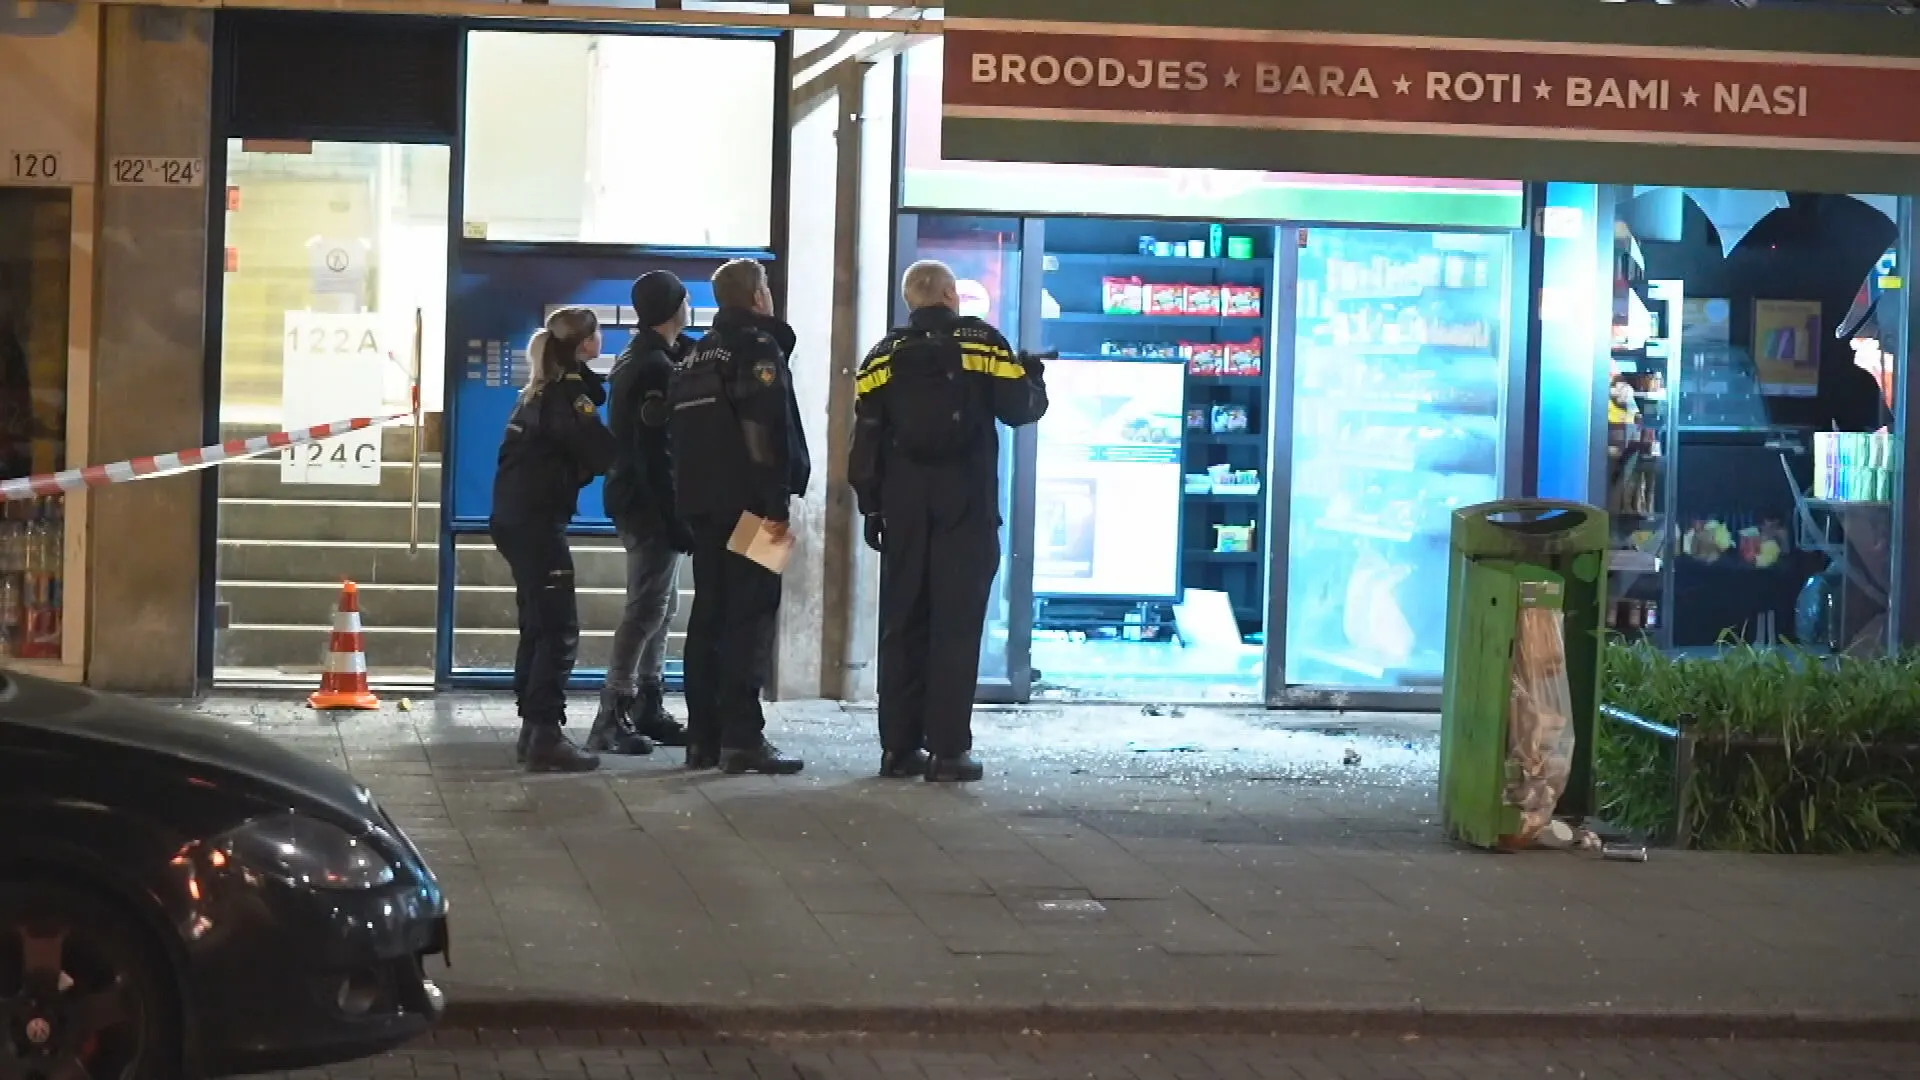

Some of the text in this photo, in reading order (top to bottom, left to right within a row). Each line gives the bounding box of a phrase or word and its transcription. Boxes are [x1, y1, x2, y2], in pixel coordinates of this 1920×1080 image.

[971, 53, 1807, 116] BROODJES BARA ROTI BAMI NASI
[14, 153, 57, 177] 120
[288, 326, 378, 353] 122A
[284, 443, 376, 469] 124C
